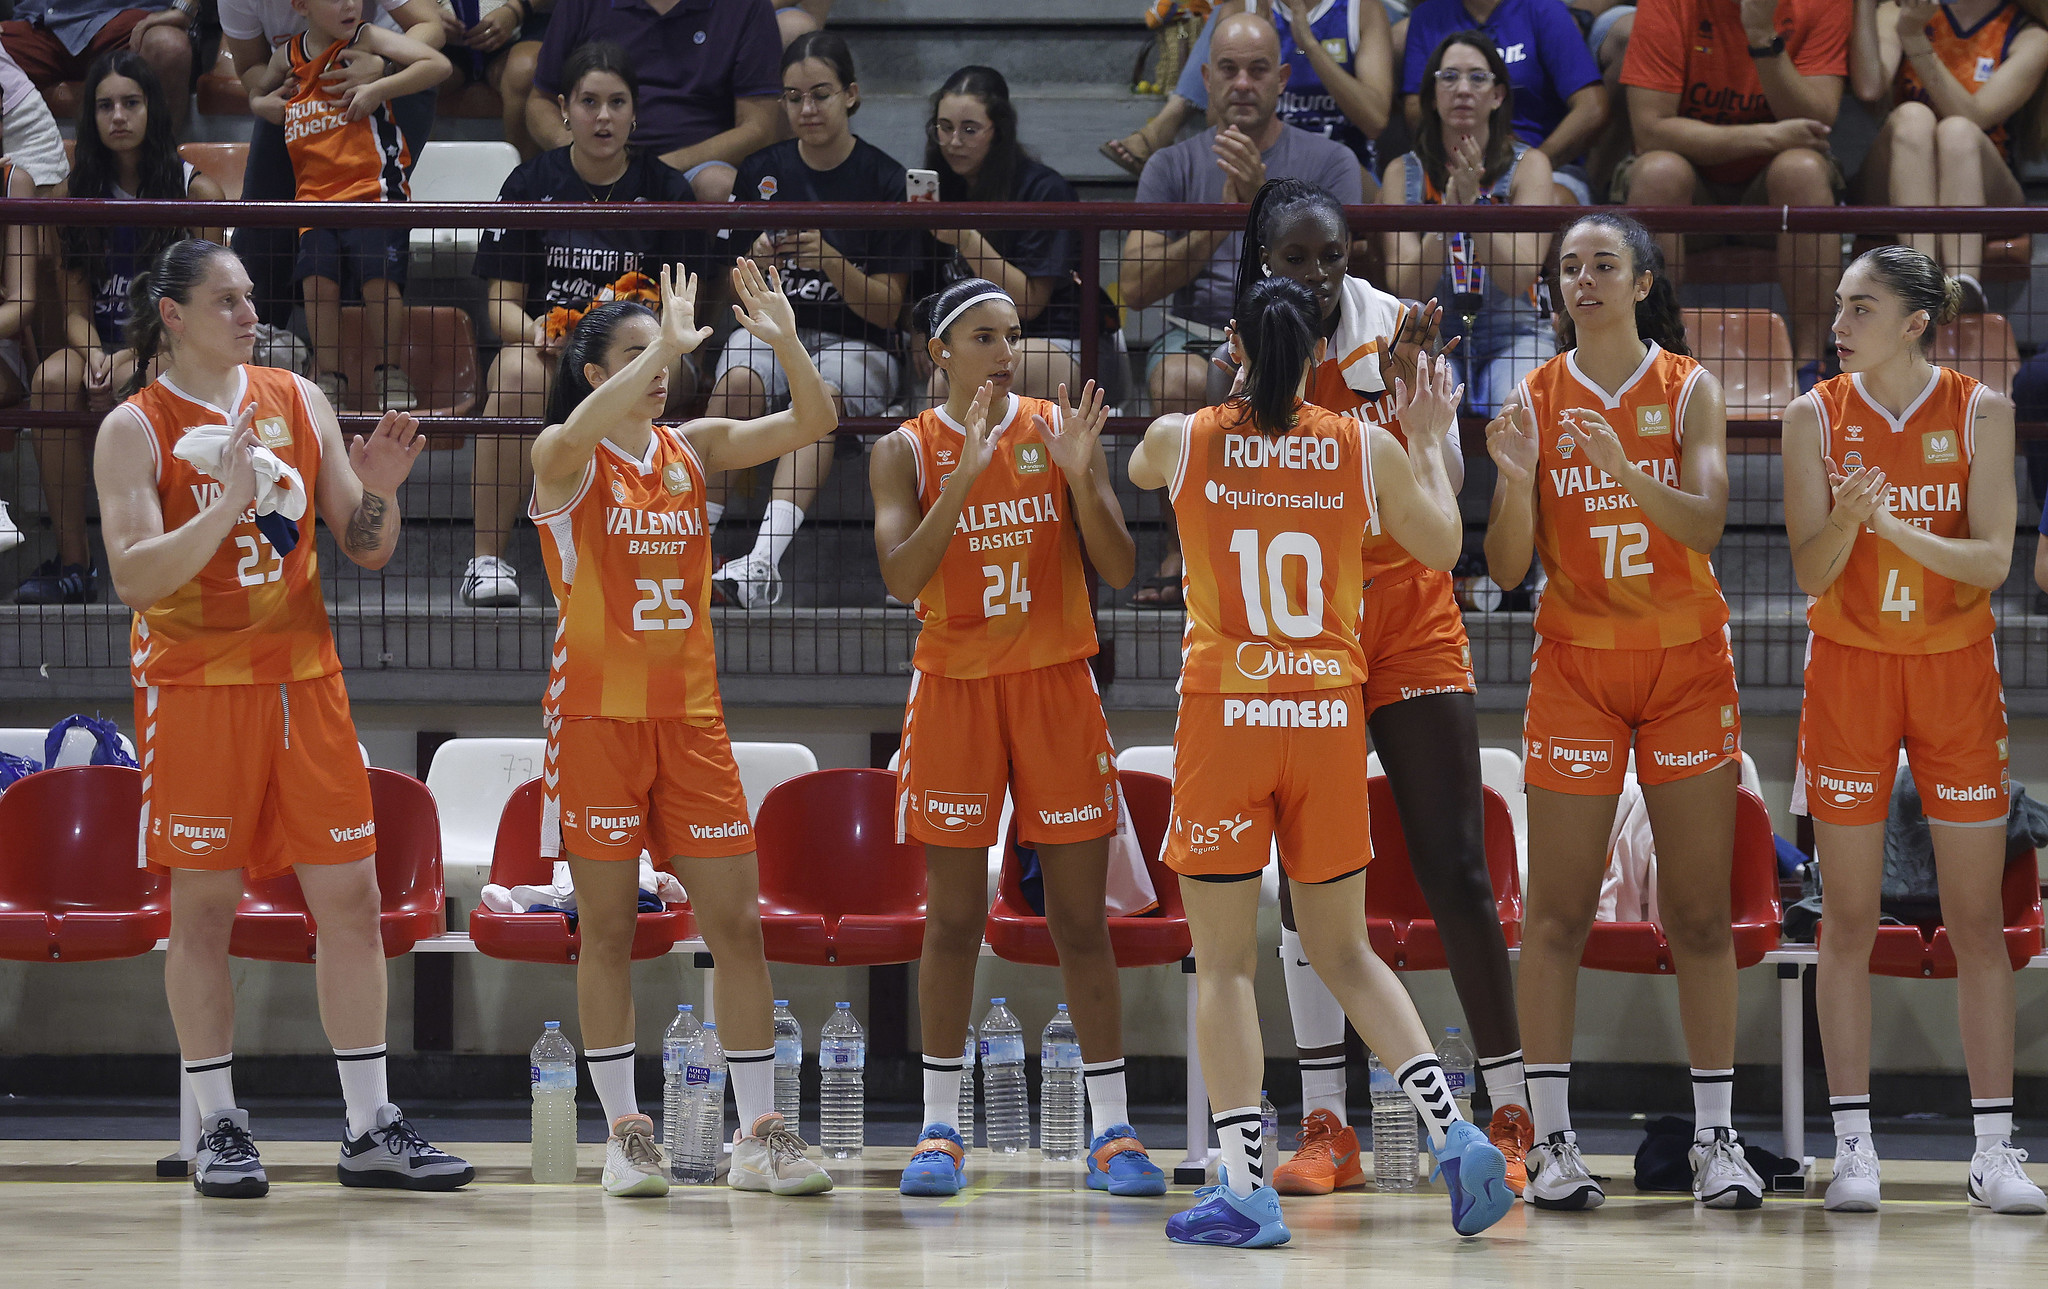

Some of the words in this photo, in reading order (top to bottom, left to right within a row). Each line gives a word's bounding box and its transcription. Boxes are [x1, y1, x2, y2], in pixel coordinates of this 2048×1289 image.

[1276, 92, 1336, 113] ltura
[1690, 83, 1768, 112] Cultur
[285, 101, 328, 123] ultura
[546, 246, 618, 272] VALENCIA
[1340, 394, 1396, 426] NCIA
[1224, 434, 1339, 470] ROMERO
[1225, 489, 1344, 510] quirónsalud
[1584, 494, 1639, 512] BASK
[1883, 483, 1961, 512] ENCIA
[606, 507, 703, 536] VALENCIA
[953, 493, 1059, 536] ALENCIA
[628, 540, 687, 555] BASKET
[968, 528, 1034, 552] BASKET
[1590, 523, 1654, 579] 72
[982, 561, 1032, 618] 24
[1229, 529, 1324, 638] 10
[1881, 569, 1916, 621] 4
[632, 579, 694, 631] 25
[1252, 650, 1341, 677] Midea
[1223, 698, 1348, 728] PAMESA
[1553, 747, 1608, 762] PULEVA
[1821, 775, 1873, 793] PULEVA
[1937, 784, 1997, 802] Vitaldin
[928, 800, 982, 815] PULEVA
[1039, 804, 1102, 825] Vitaldin
[173, 823, 226, 839] PULEVA
[591, 815, 640, 829] PULEVA
[689, 820, 749, 839] Vitaldin
[1189, 844, 1220, 855] Seguros
